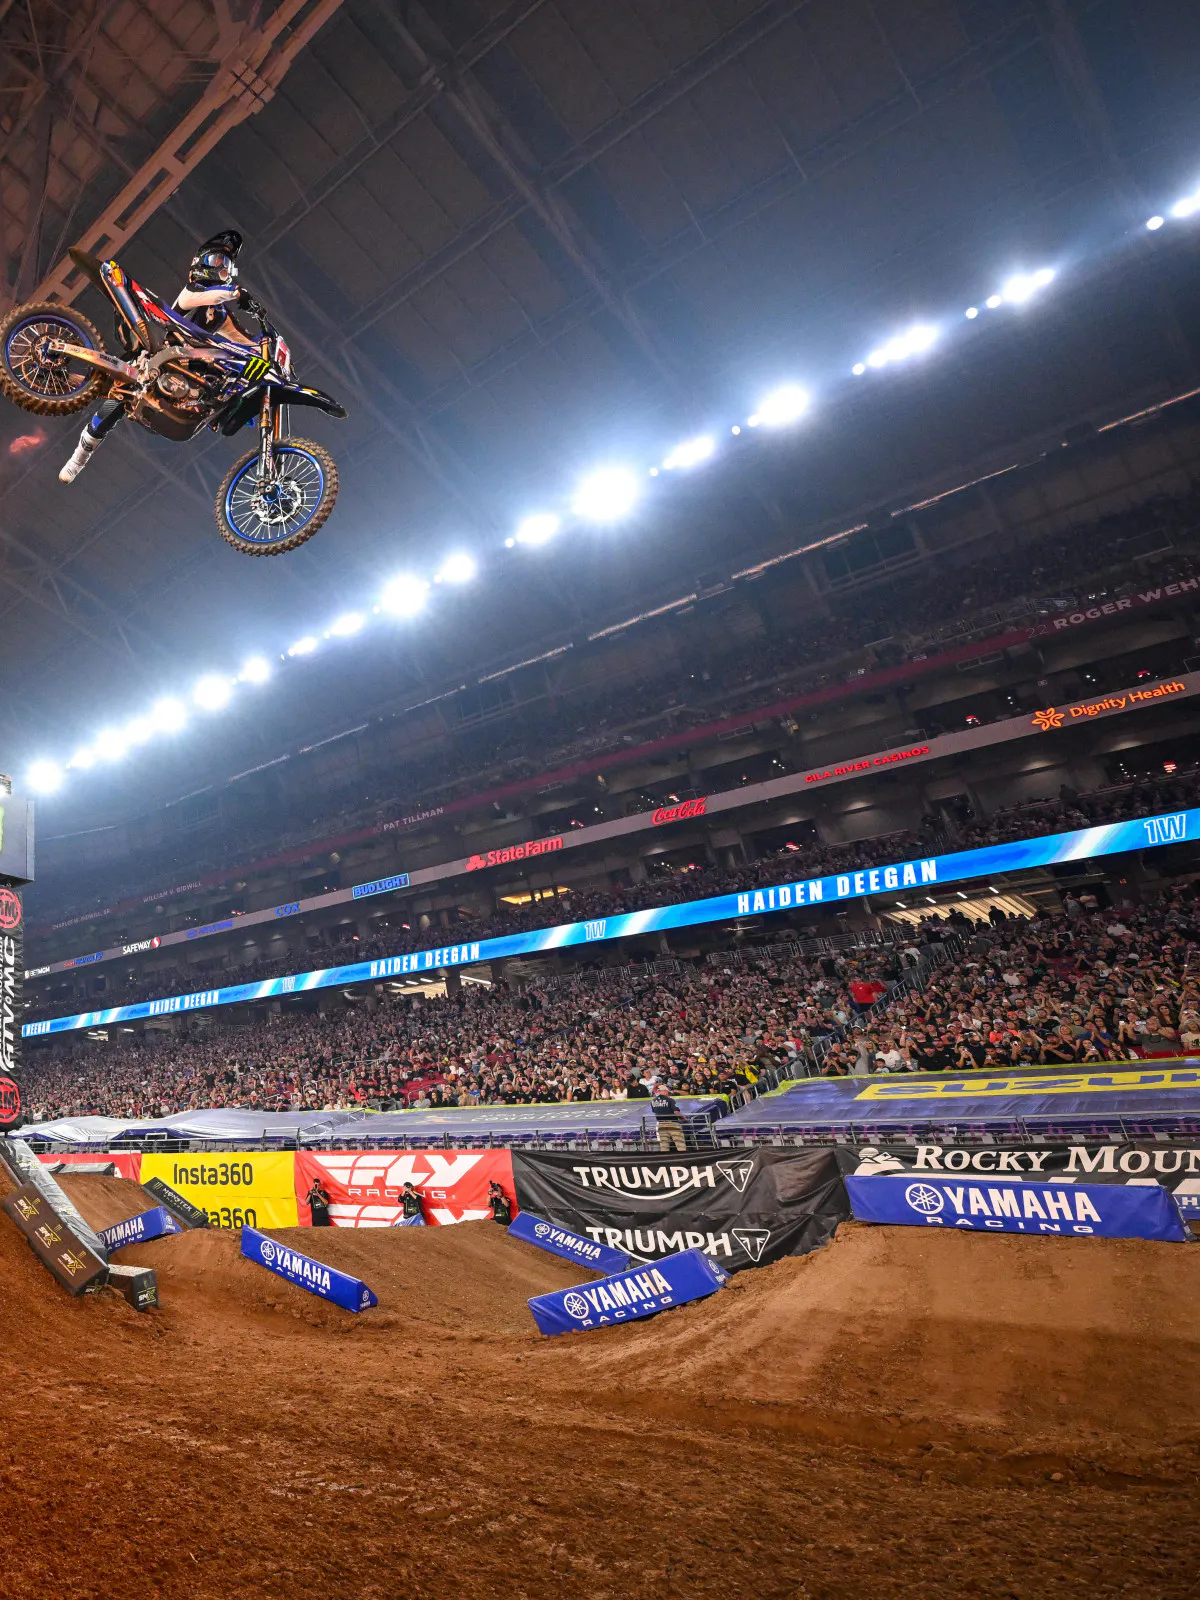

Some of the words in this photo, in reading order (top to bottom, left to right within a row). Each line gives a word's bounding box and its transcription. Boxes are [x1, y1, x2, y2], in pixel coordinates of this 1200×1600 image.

[1053, 599, 1133, 629] ROGER
[1137, 577, 1200, 602] WEH
[1069, 697, 1127, 717] Dignity
[1128, 681, 1186, 703] Health
[805, 770, 832, 783] GILA
[834, 761, 871, 776] RIVER
[873, 746, 930, 767] CASINOS
[383, 819, 400, 831] PAT
[403, 807, 444, 825] TILLMAN
[652, 797, 707, 825] Coca-Cola
[1143, 813, 1187, 844] 1W
[354, 883, 375, 897] BUD
[376, 875, 408, 891] LIGHT
[737, 879, 823, 913] HAIDEN
[836, 859, 937, 897] DEEGAN
[275, 903, 300, 917] COX
[585, 920, 606, 940] 1W
[122, 940, 152, 955] SAFEWAY
[370, 954, 419, 977] HAIDEN
[425, 943, 480, 968] DEEGAN
[30, 966, 50, 978] BETMGM
[150, 997, 180, 1014] HAIDEN
[184, 990, 219, 1008] DEEGAN
[912, 1145, 1053, 1171] ROCKY
[173, 1163, 254, 1186] Insta360
[573, 1165, 716, 1199] TRIUMPH
[162, 1187, 193, 1212] MONSTER
[348, 1187, 447, 1199] RACNG
[942, 1185, 1102, 1223] YAMAHA
[105, 1217, 145, 1244] YAMAHA
[926, 1216, 1094, 1233] RACING
[107, 1233, 143, 1250] ACING
[550, 1228, 602, 1259] YAMAHA
[586, 1226, 733, 1262] TRIUMPH
[265, 1260, 327, 1294] RACING
[274, 1247, 331, 1290] YAMAHA
[583, 1268, 673, 1313] YAMAHA
[582, 1296, 673, 1326] RACING
